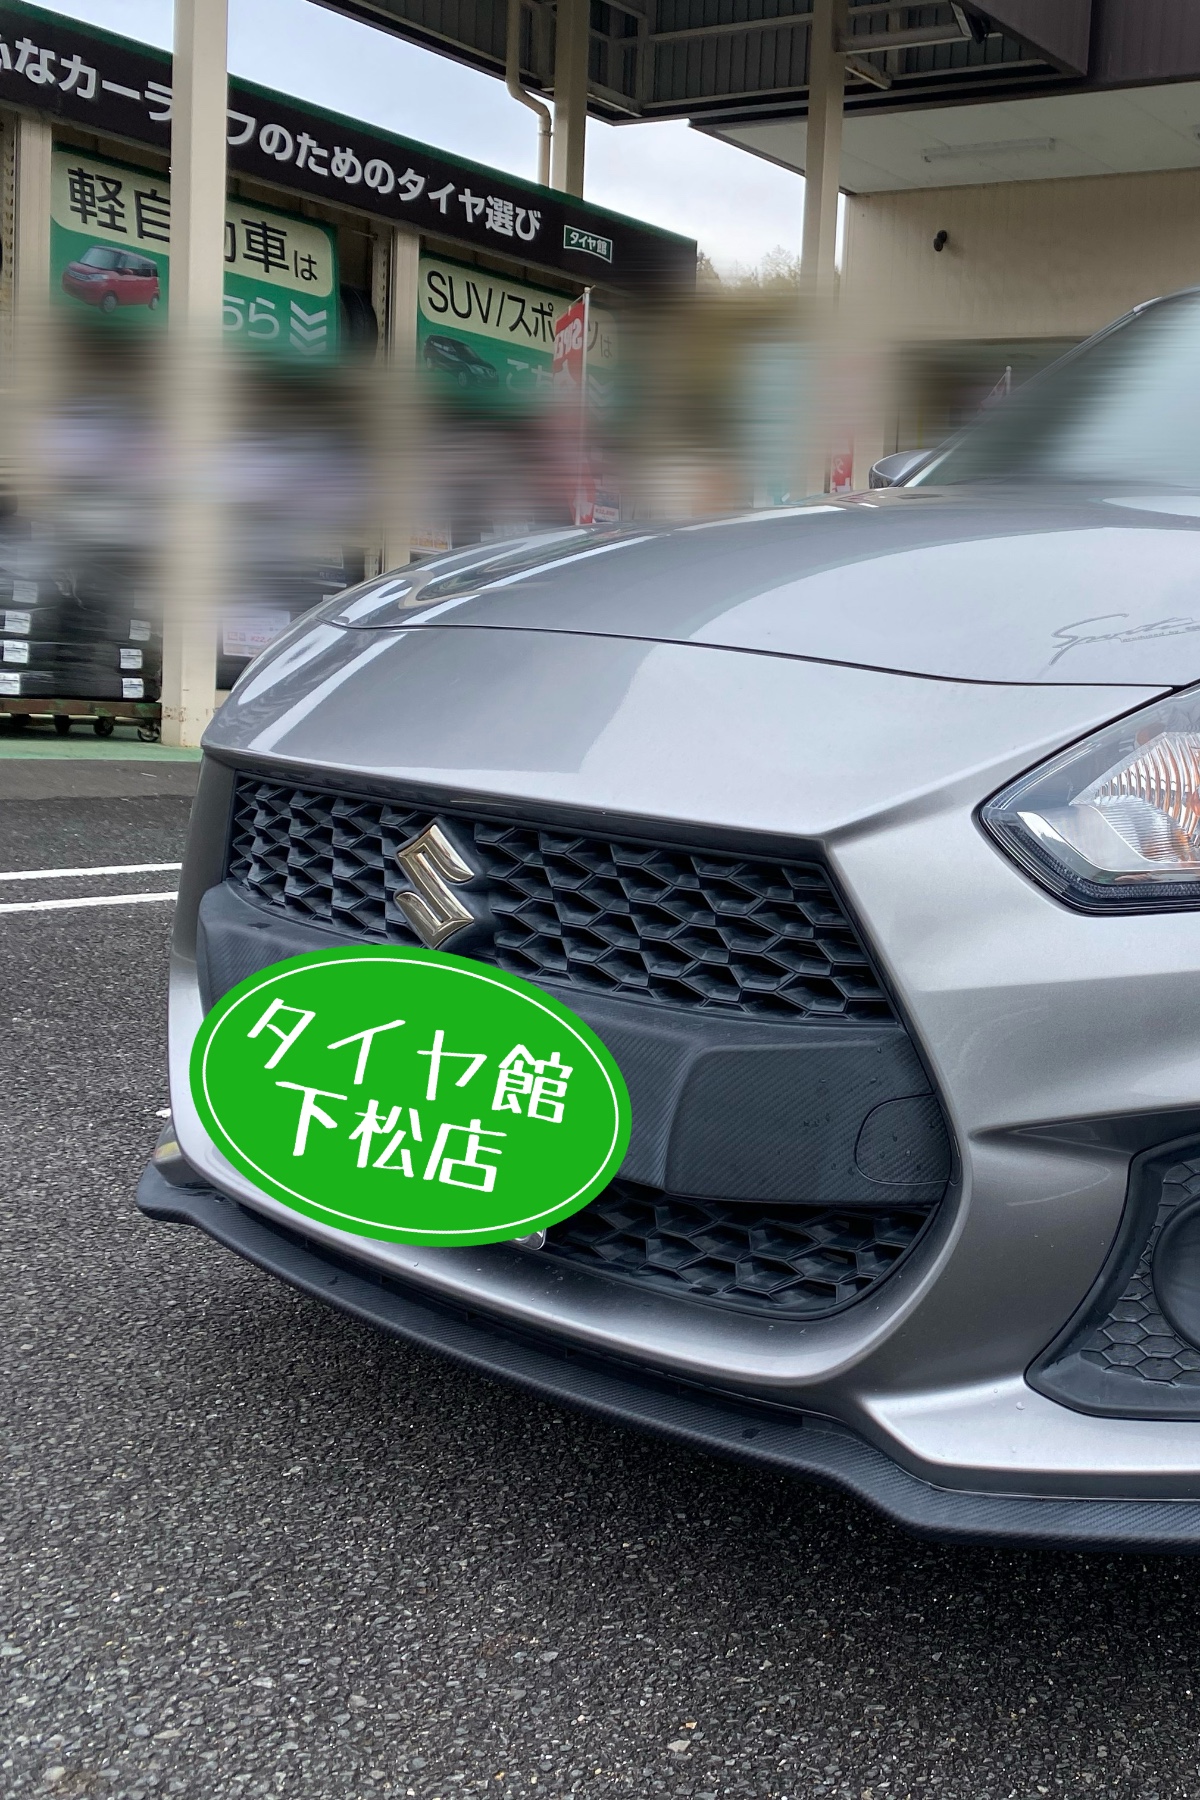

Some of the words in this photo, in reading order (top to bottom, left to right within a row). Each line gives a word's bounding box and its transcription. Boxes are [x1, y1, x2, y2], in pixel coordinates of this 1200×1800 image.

[0, 34, 542, 241] なカーラフのためのタイヤ選び
[67, 168, 318, 281] 軽自車は
[569, 231, 608, 256] タイヤ館
